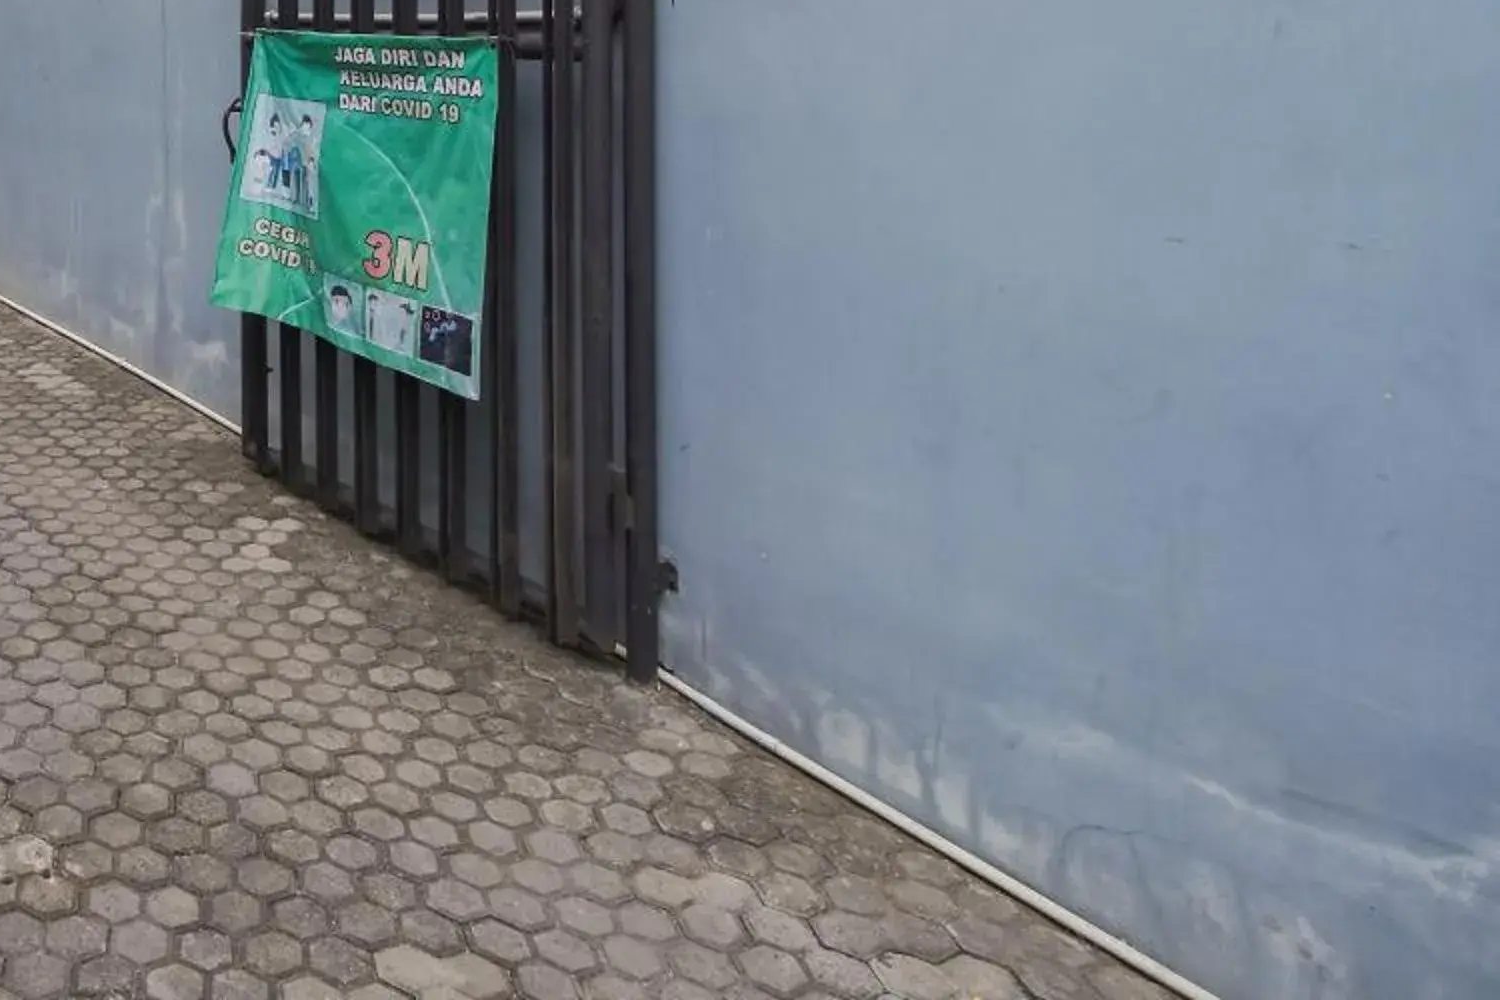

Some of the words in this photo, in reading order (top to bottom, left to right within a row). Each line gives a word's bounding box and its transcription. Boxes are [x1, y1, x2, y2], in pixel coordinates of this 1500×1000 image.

[334, 46, 376, 65] JAGA
[381, 48, 419, 67] DIRI
[423, 50, 465, 69] DAN
[339, 69, 427, 93] KELUARGA
[432, 76, 484, 97] ANDA
[339, 93, 376, 113] DARI
[381, 97, 433, 119] COVID
[439, 104, 460, 123] 19
[238, 239, 301, 268] COVID
[362, 229, 431, 292] 3M
